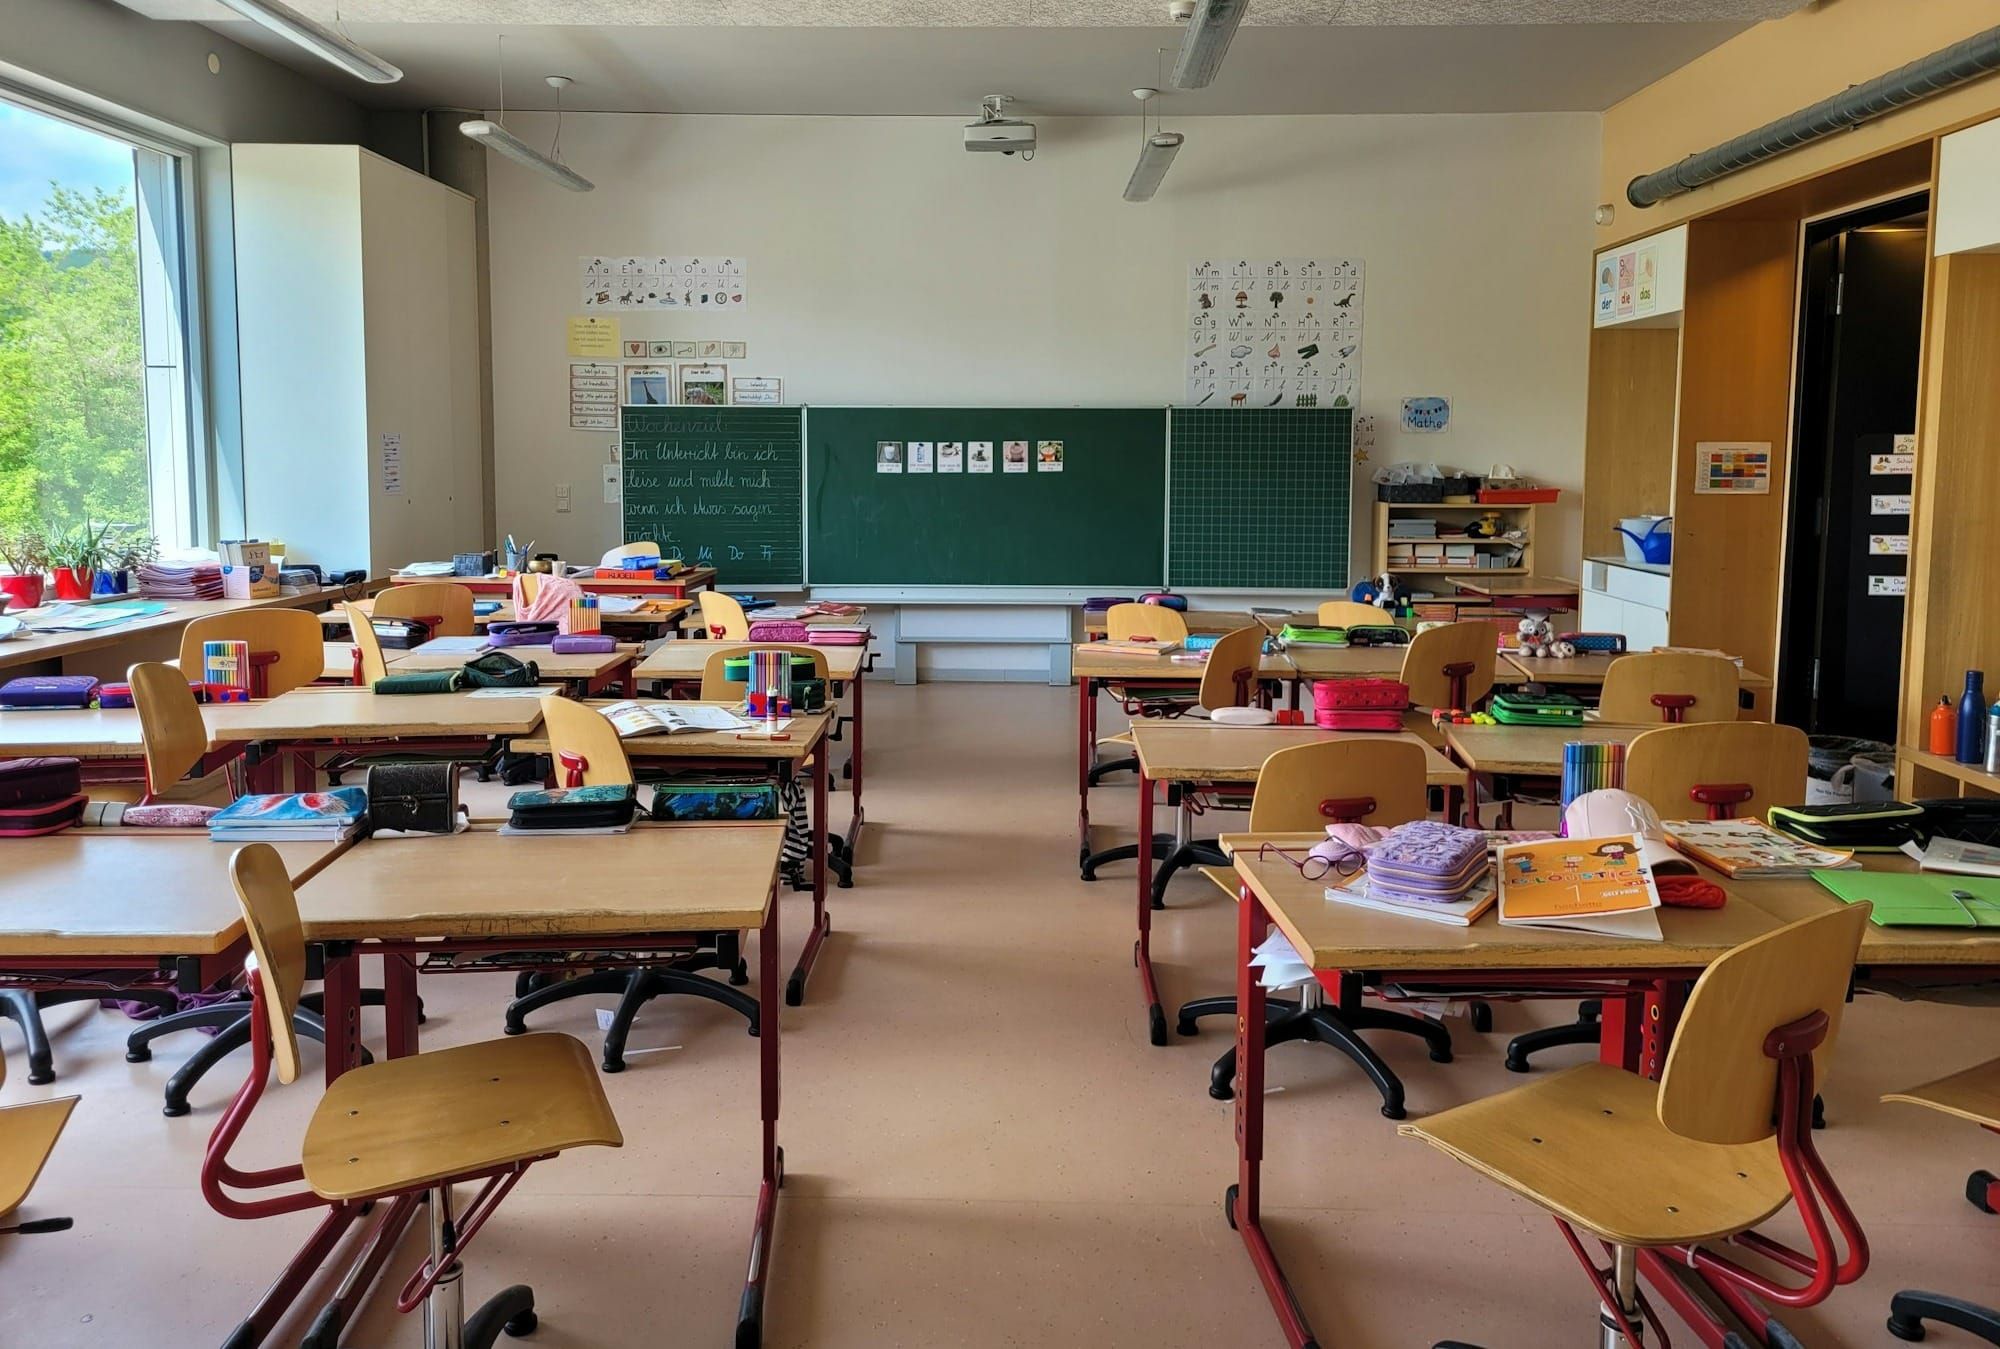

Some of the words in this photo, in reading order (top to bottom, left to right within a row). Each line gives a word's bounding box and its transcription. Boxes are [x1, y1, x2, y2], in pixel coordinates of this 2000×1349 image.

[1621, 291, 1631, 304] die
[1640, 288, 1651, 300] das
[1601, 296, 1612, 310] der
[1407, 415, 1442, 429] Mathe
[625, 441, 649, 460] Im
[656, 441, 719, 460] Unterricht
[724, 441, 749, 460] bin
[753, 442, 778, 461] ich
[627, 469, 660, 488] leise
[668, 470, 694, 488] und
[740, 469, 771, 488] mich
[627, 503, 659, 516] wenn
[664, 496, 687, 515] ich
[693, 498, 727, 515] etwas
[731, 503, 773, 522] sagen
[671, 546, 685, 560] Di
[698, 545, 713, 560] Mi
[728, 545, 744, 560] Do
